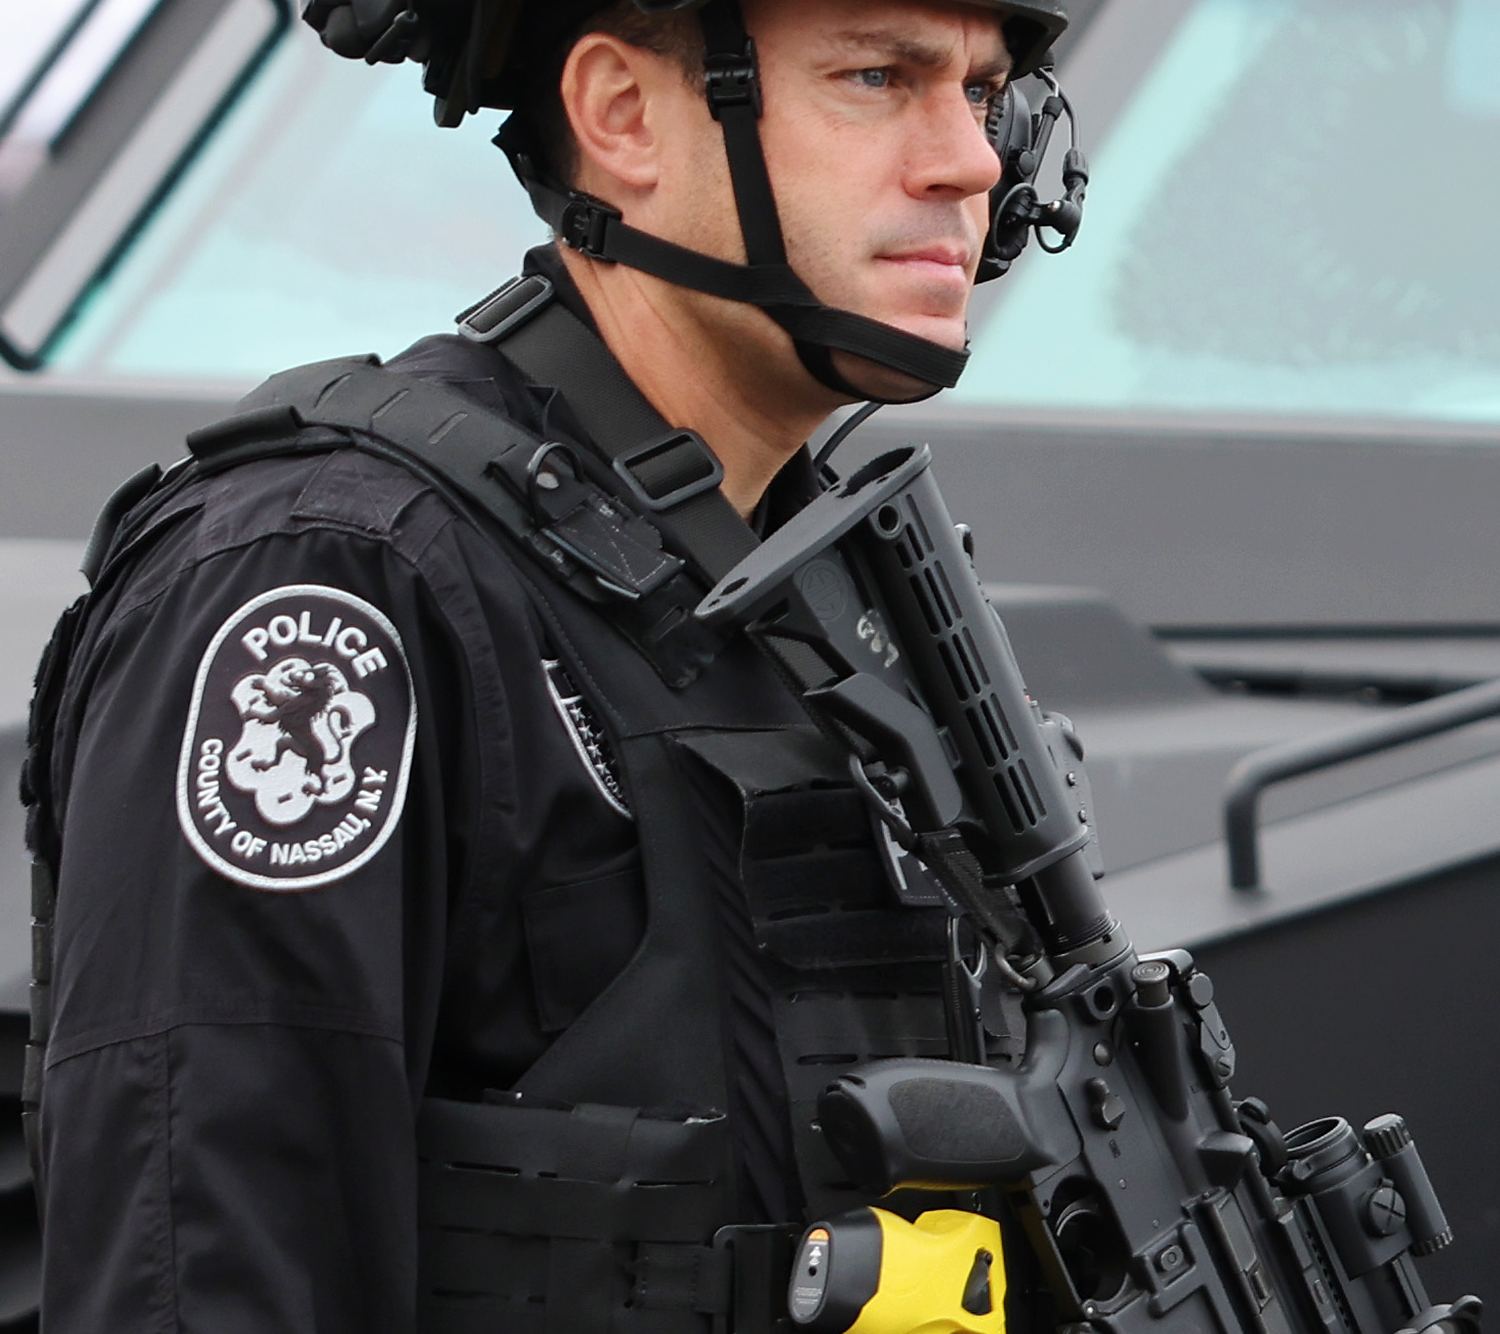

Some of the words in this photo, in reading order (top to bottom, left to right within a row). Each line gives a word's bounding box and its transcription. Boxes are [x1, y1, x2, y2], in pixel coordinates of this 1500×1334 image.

[240, 611, 387, 679] POLICE
[197, 738, 237, 836] COUNTY
[231, 831, 267, 858] OF
[354, 766, 389, 811] N.Y.
